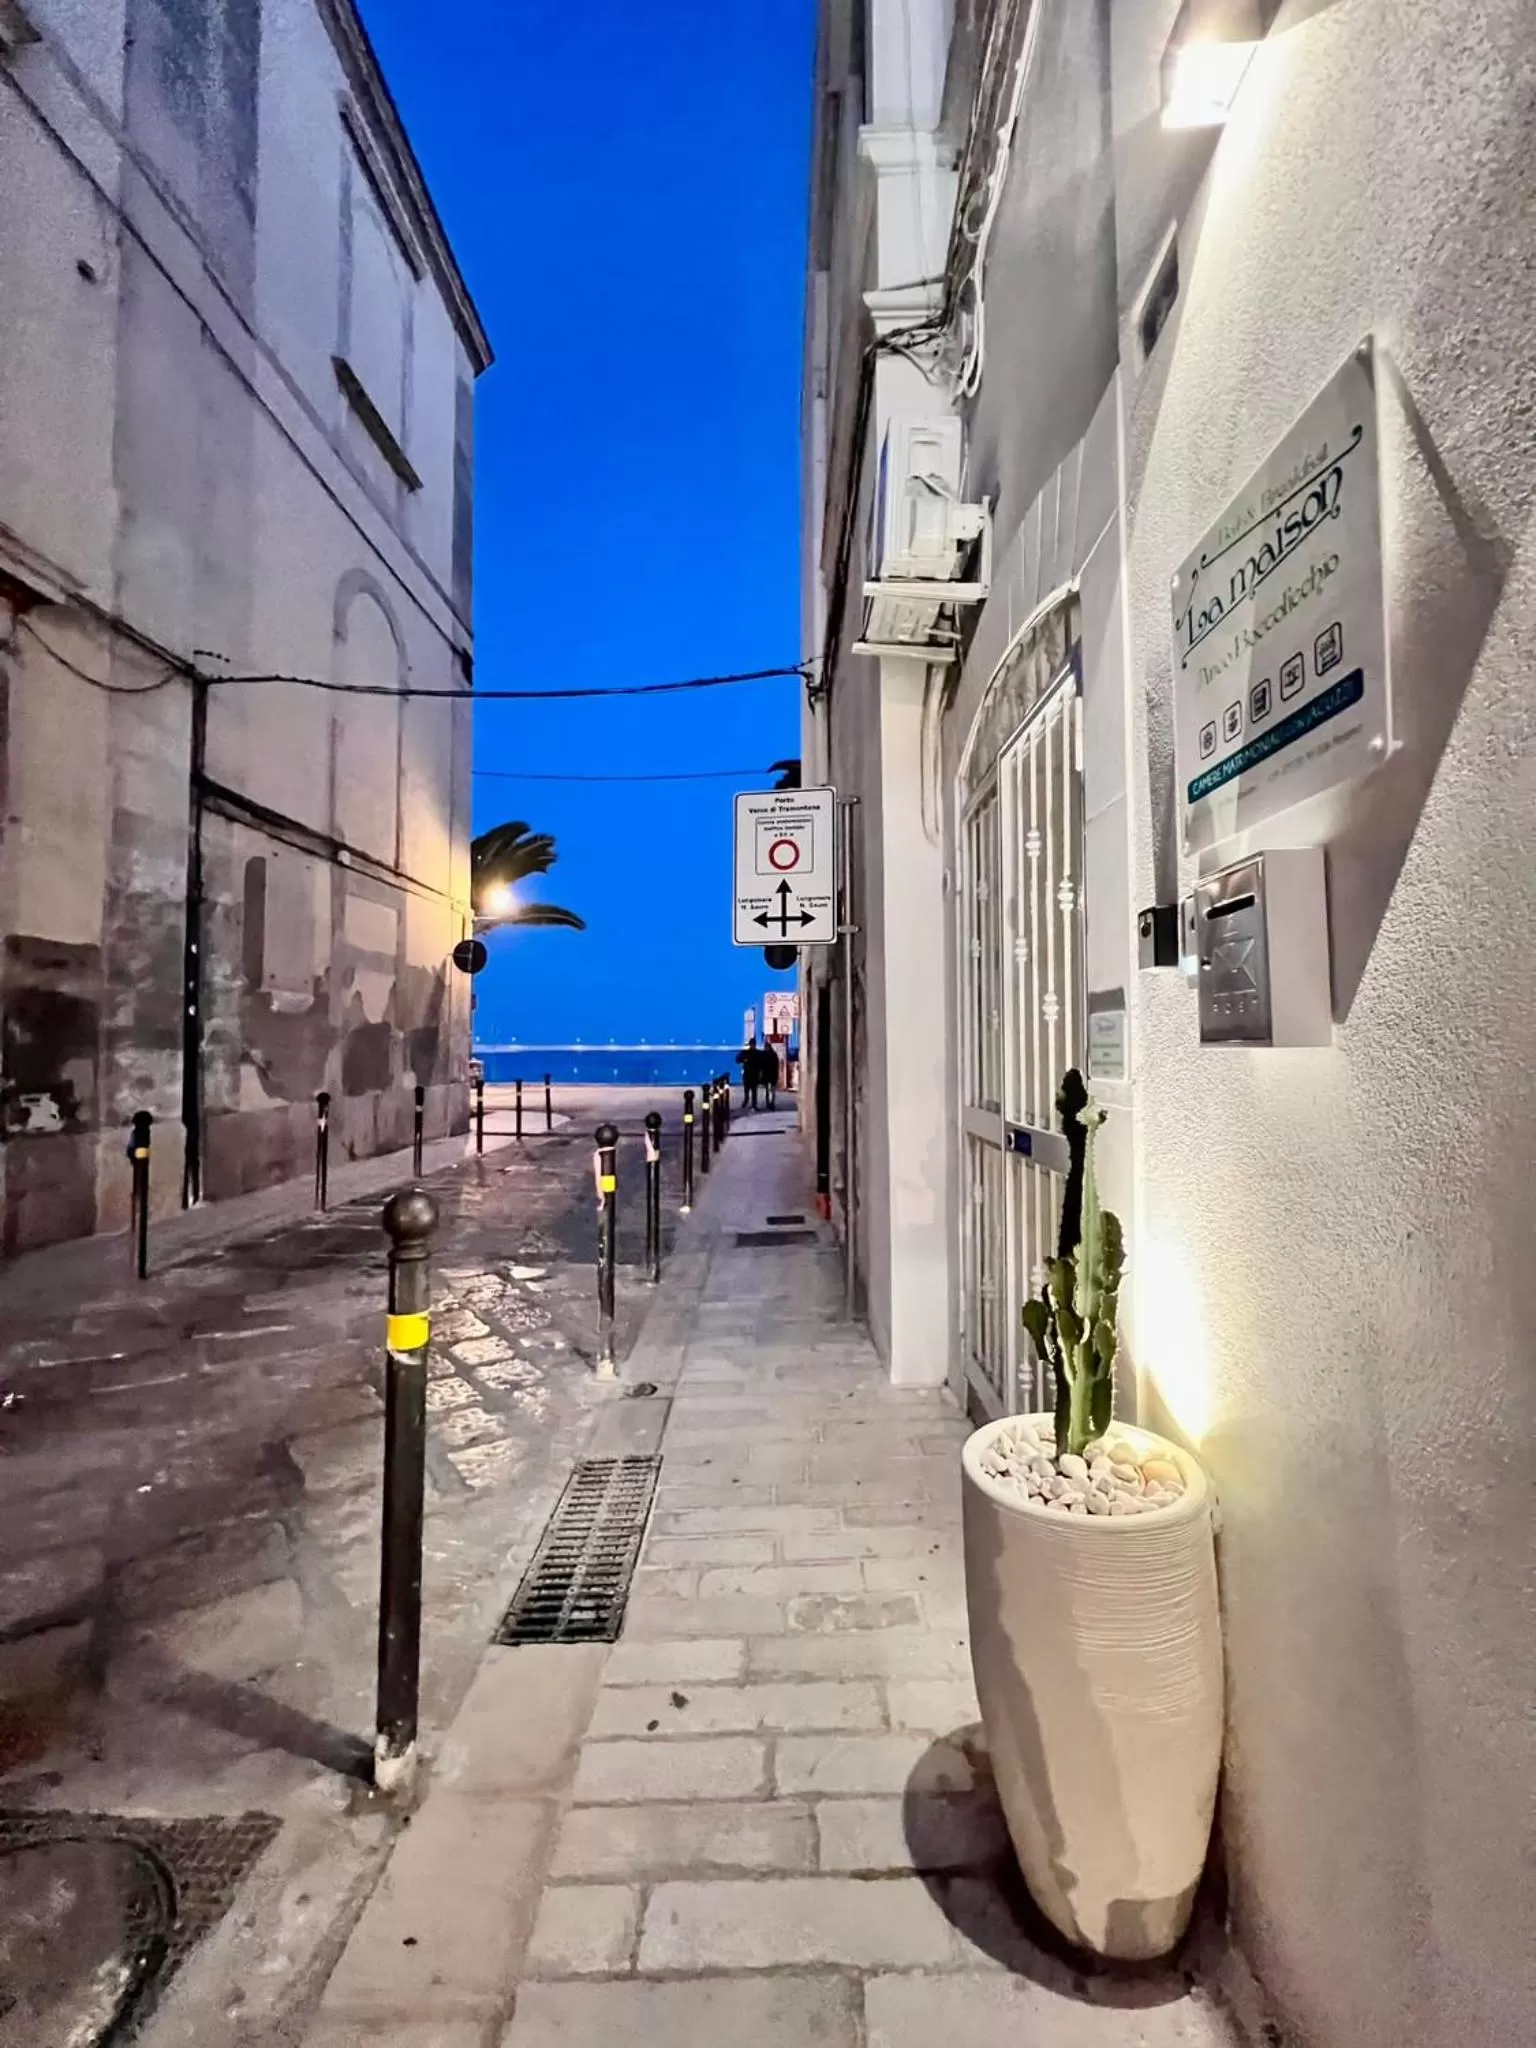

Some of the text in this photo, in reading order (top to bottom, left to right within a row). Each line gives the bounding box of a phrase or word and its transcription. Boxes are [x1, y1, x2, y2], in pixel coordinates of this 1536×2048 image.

[1184, 466, 1343, 646] La maison
[1192, 768, 1222, 796] CAMERE
